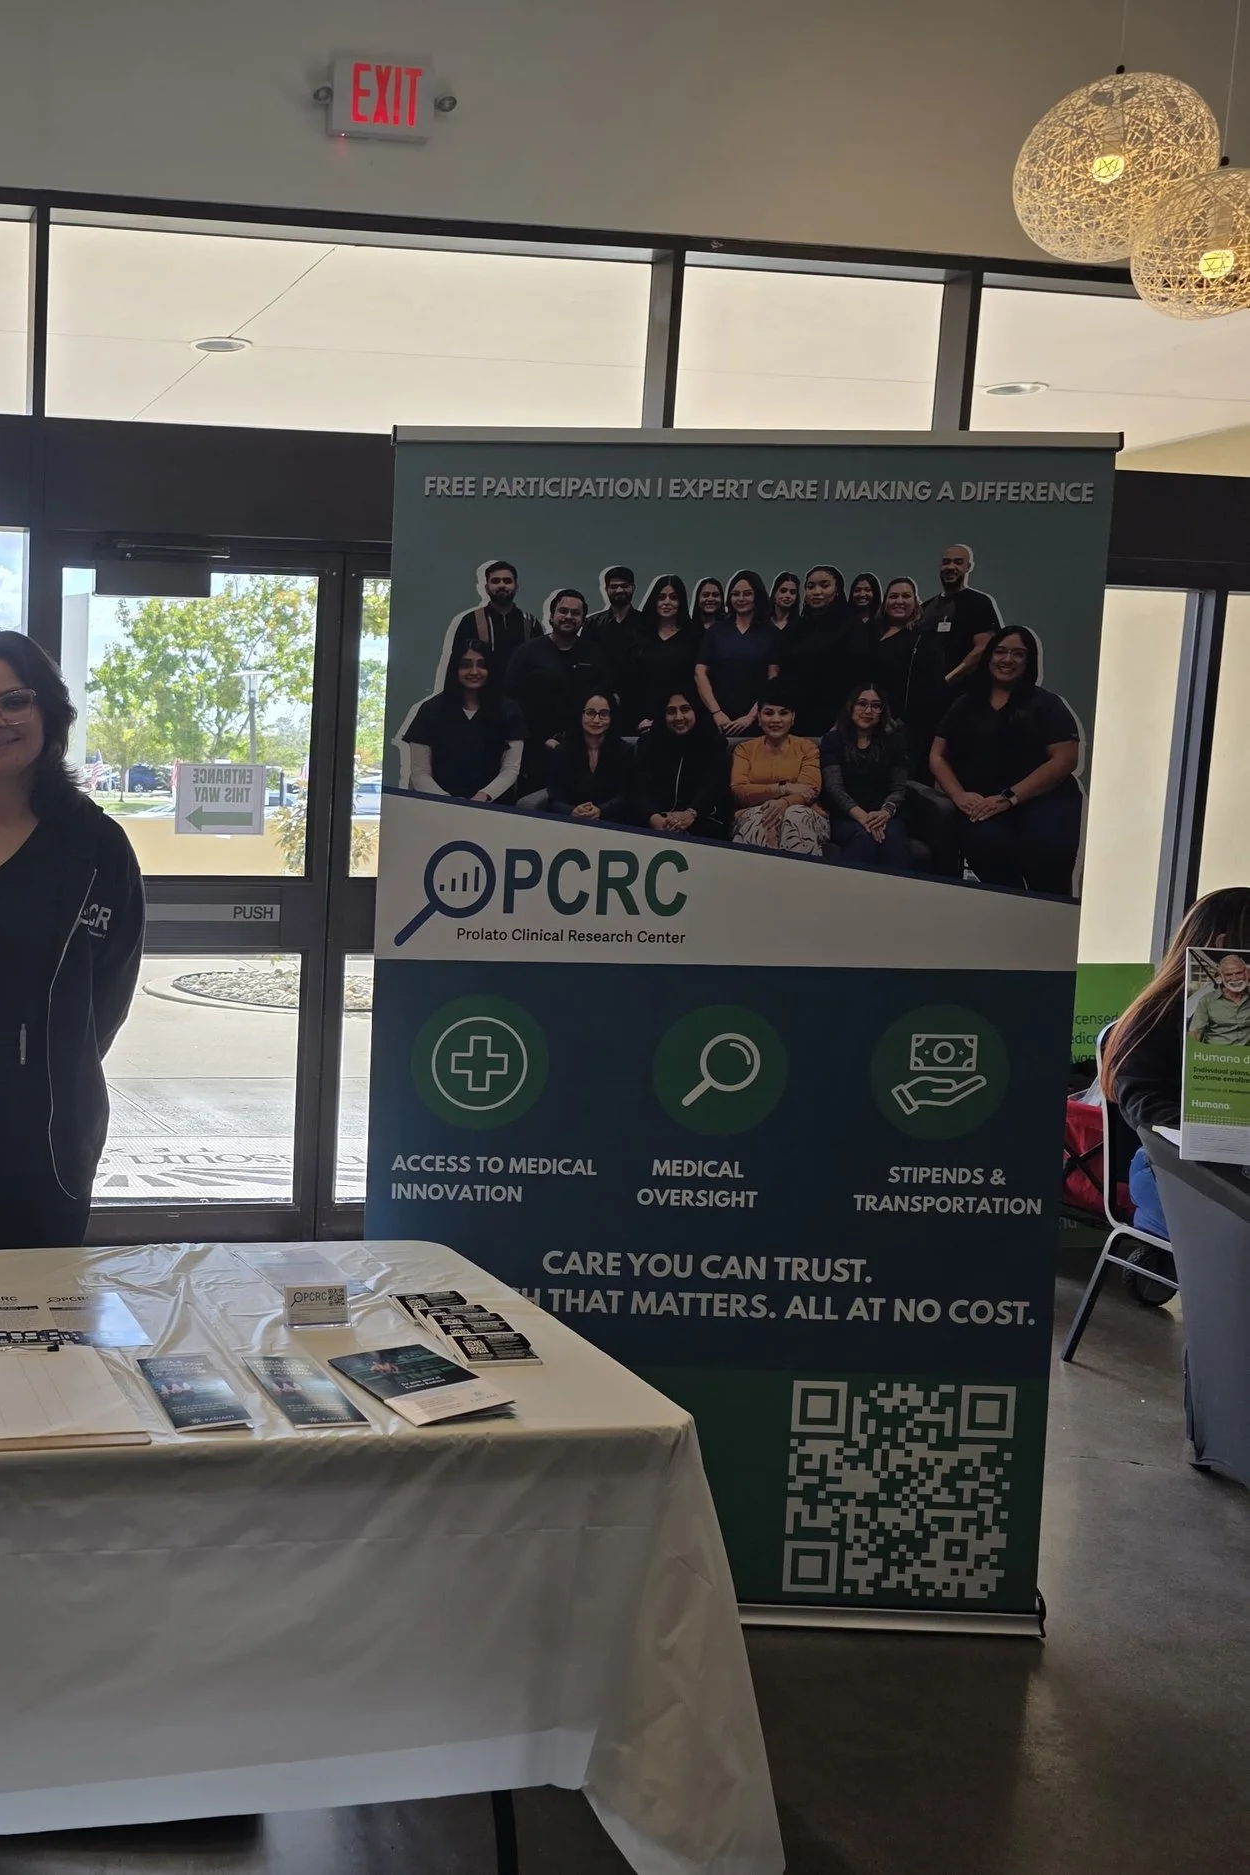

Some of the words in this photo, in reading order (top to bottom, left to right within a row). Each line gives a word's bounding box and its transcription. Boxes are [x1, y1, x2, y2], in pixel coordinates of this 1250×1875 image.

[351, 62, 424, 128] EXIT
[424, 476, 476, 497] FREE
[481, 476, 651, 499] PARTICIPATION
[668, 478, 753, 500] EXPERT
[757, 479, 818, 501] CARE
[835, 480, 932, 501] MAKING
[936, 481, 955, 501] A
[960, 481, 1095, 503] DIFFERENCE
[502, 847, 690, 918] PCRC
[233, 906, 274, 920] PUSH
[456, 927, 508, 941] Prolato
[511, 928, 564, 942] Clinical
[568, 929, 633, 943] Research
[637, 930, 686, 944] Center
[1193, 1051, 1240, 1064] Humana
[1191, 1099, 1231, 1110] Humana
[391, 1154, 471, 1173] ACCESS
[476, 1156, 504, 1174] TO
[508, 1157, 598, 1176] MEDICAL
[651, 1159, 745, 1179] MEDICAL
[887, 1166, 985, 1186] STIPENDS
[992, 1168, 1007, 1186] &
[391, 1183, 523, 1202] INNOVATION
[636, 1188, 759, 1209] OVERSIGHT
[853, 1194, 1043, 1216] TRANSPORTATION
[542, 1250, 622, 1276] CARE
[626, 1252, 694, 1278] YOU
[700, 1255, 767, 1280] CAN
[773, 1256, 873, 1284] TRUST.
[303, 1291, 327, 1302] PCRC
[548, 1288, 624, 1314] THAT
[630, 1291, 777, 1319] MATTERS.
[784, 1295, 839, 1320] ALL
[846, 1297, 886, 1321] AT
[893, 1298, 942, 1323] NO
[948, 1299, 1036, 1325] COST.
